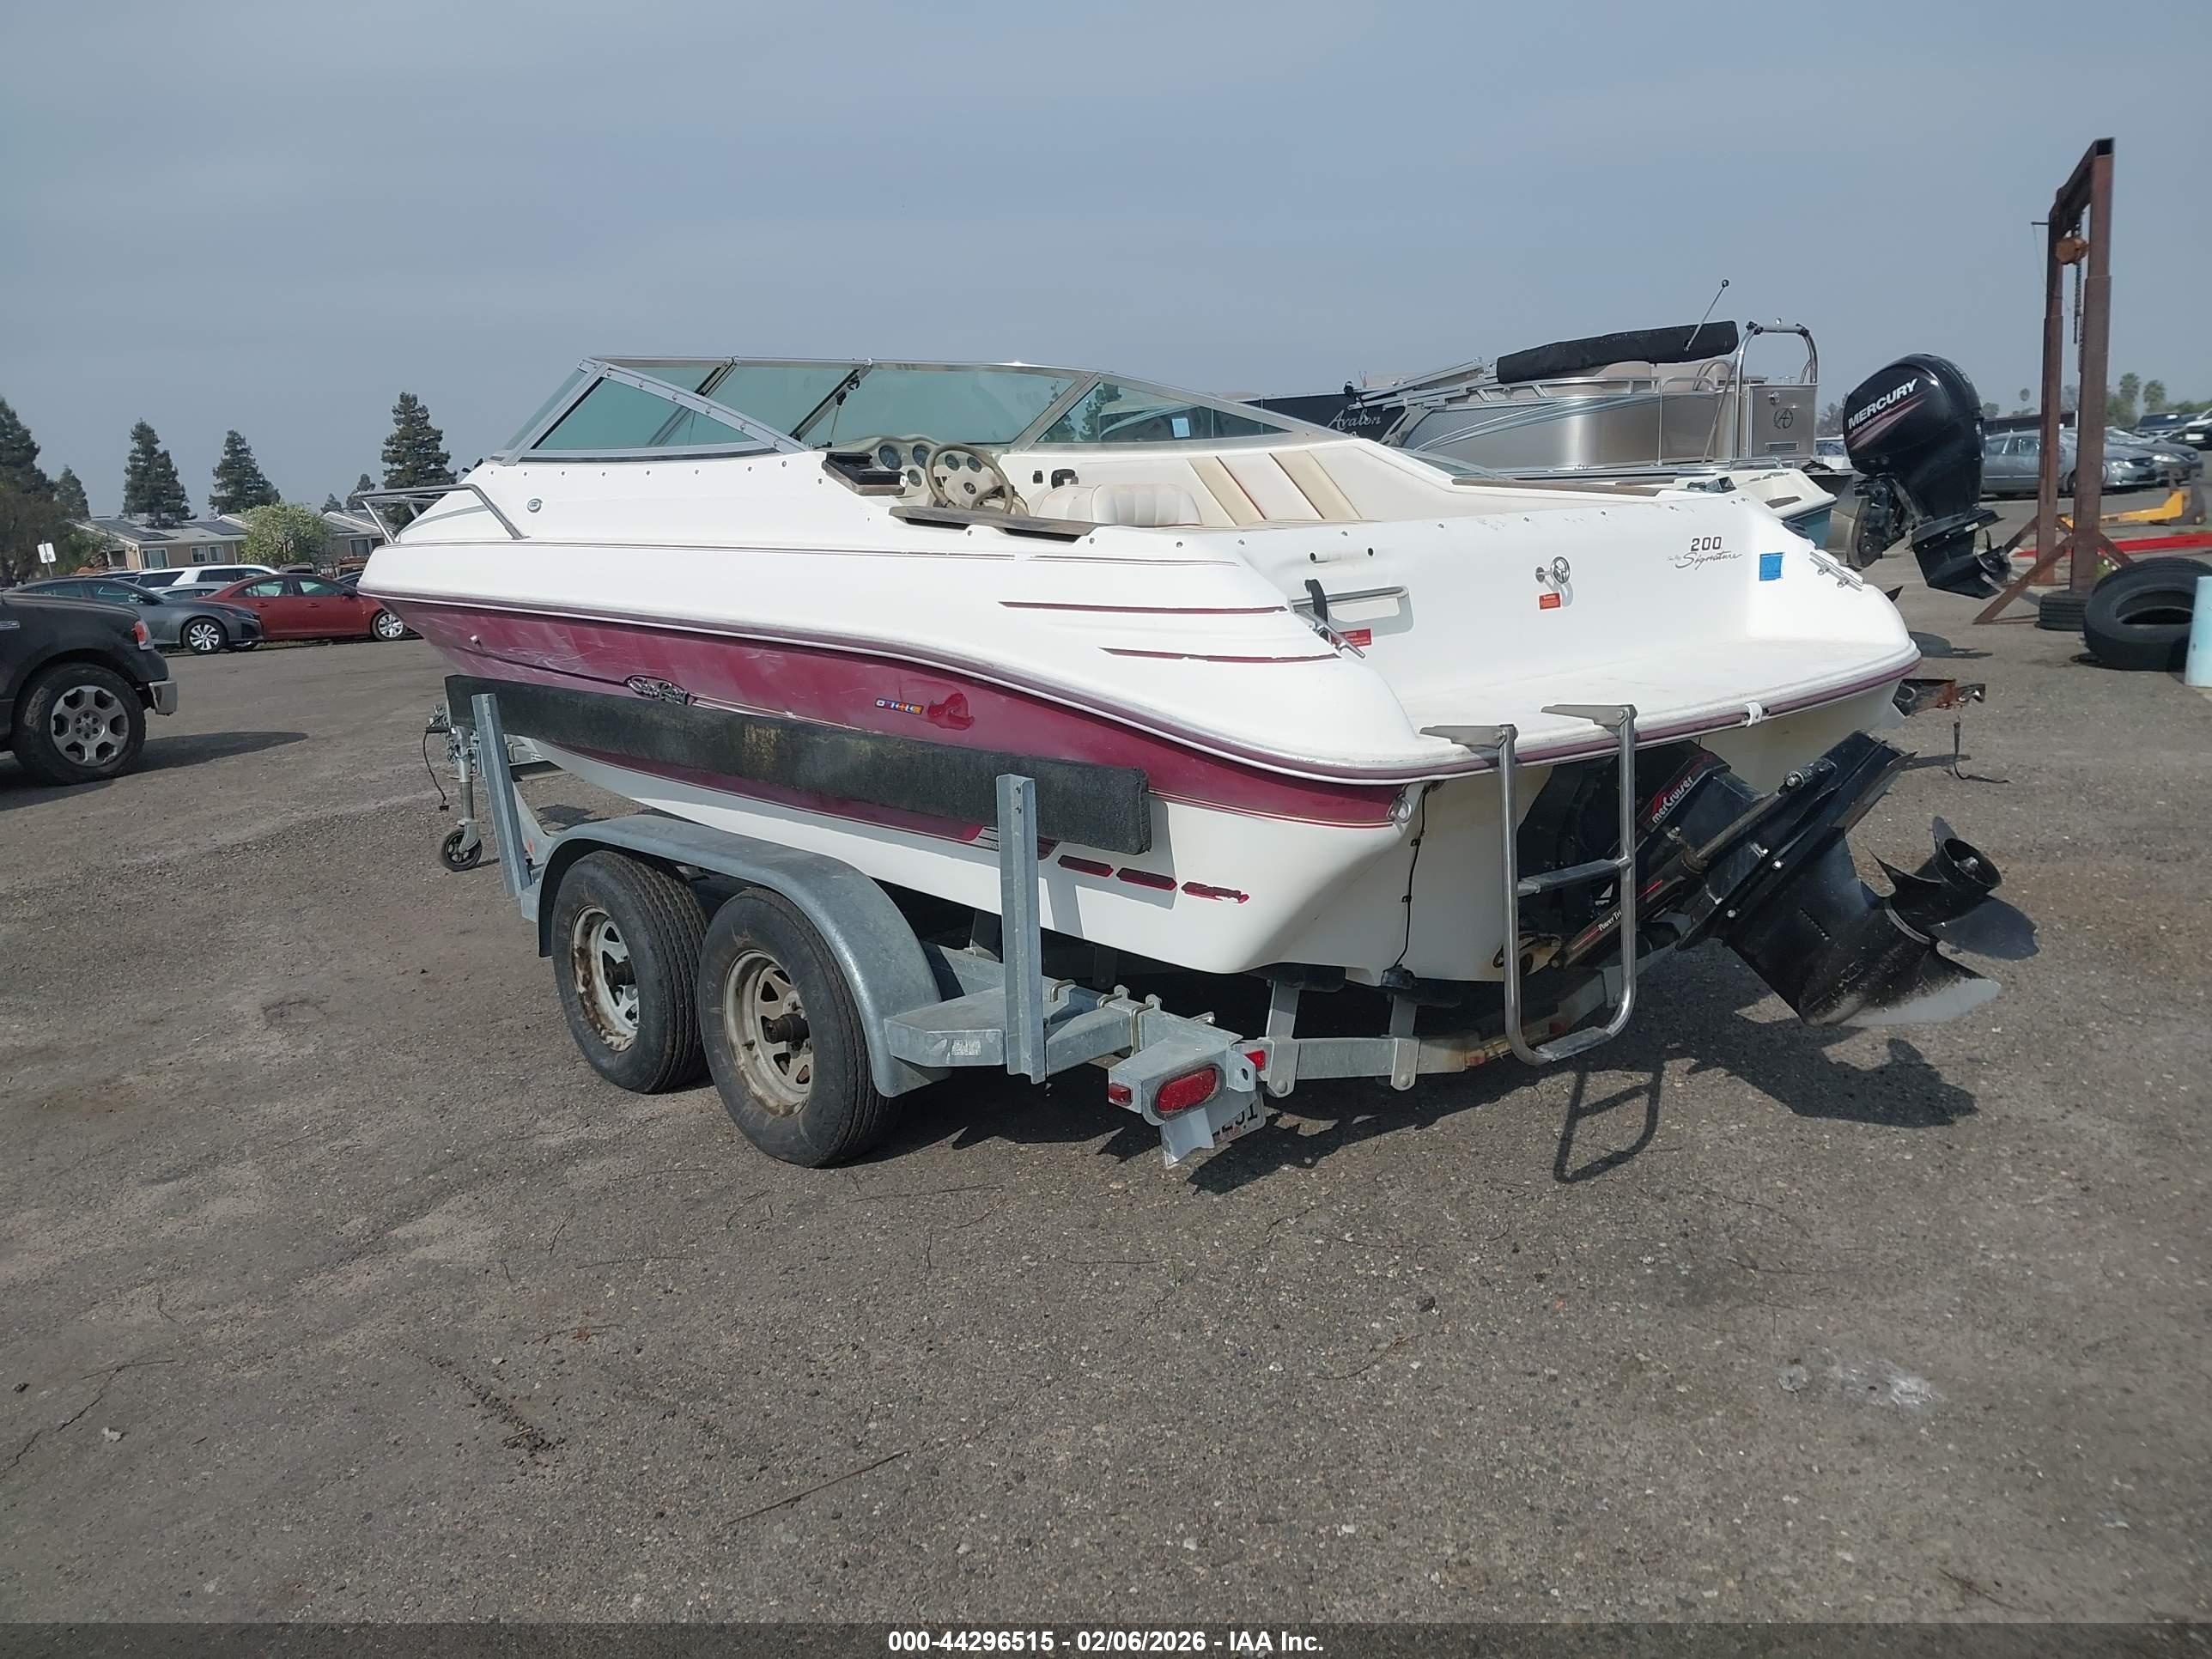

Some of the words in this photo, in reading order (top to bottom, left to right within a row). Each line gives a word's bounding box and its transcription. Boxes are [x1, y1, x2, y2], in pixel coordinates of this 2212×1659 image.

[1848, 378, 1918, 430] MERCURY
[1326, 408, 1382, 431] Avalon
[1690, 536, 1723, 552] 200
[1674, 550, 1743, 570] Signature
